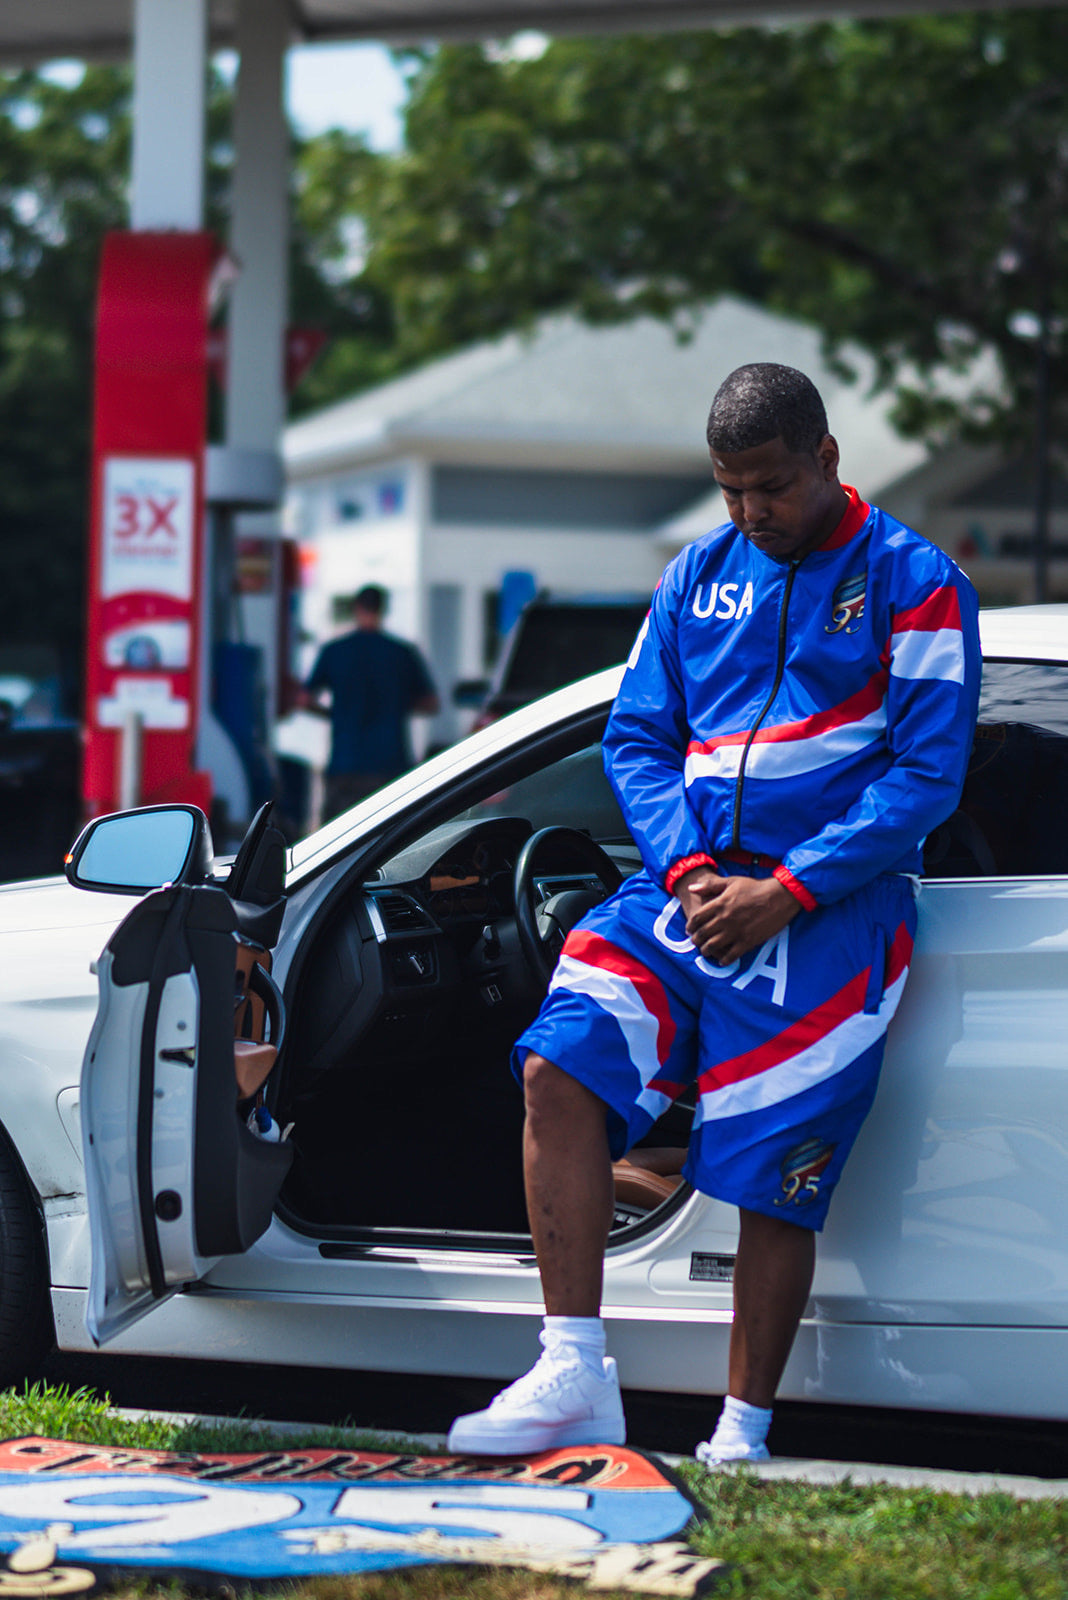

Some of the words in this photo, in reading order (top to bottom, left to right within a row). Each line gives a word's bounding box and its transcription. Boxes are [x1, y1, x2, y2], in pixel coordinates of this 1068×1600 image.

[114, 495, 178, 538] 3X
[692, 582, 753, 619] USA
[774, 1174, 820, 1206] 95
[0, 1477, 606, 1553] 95
